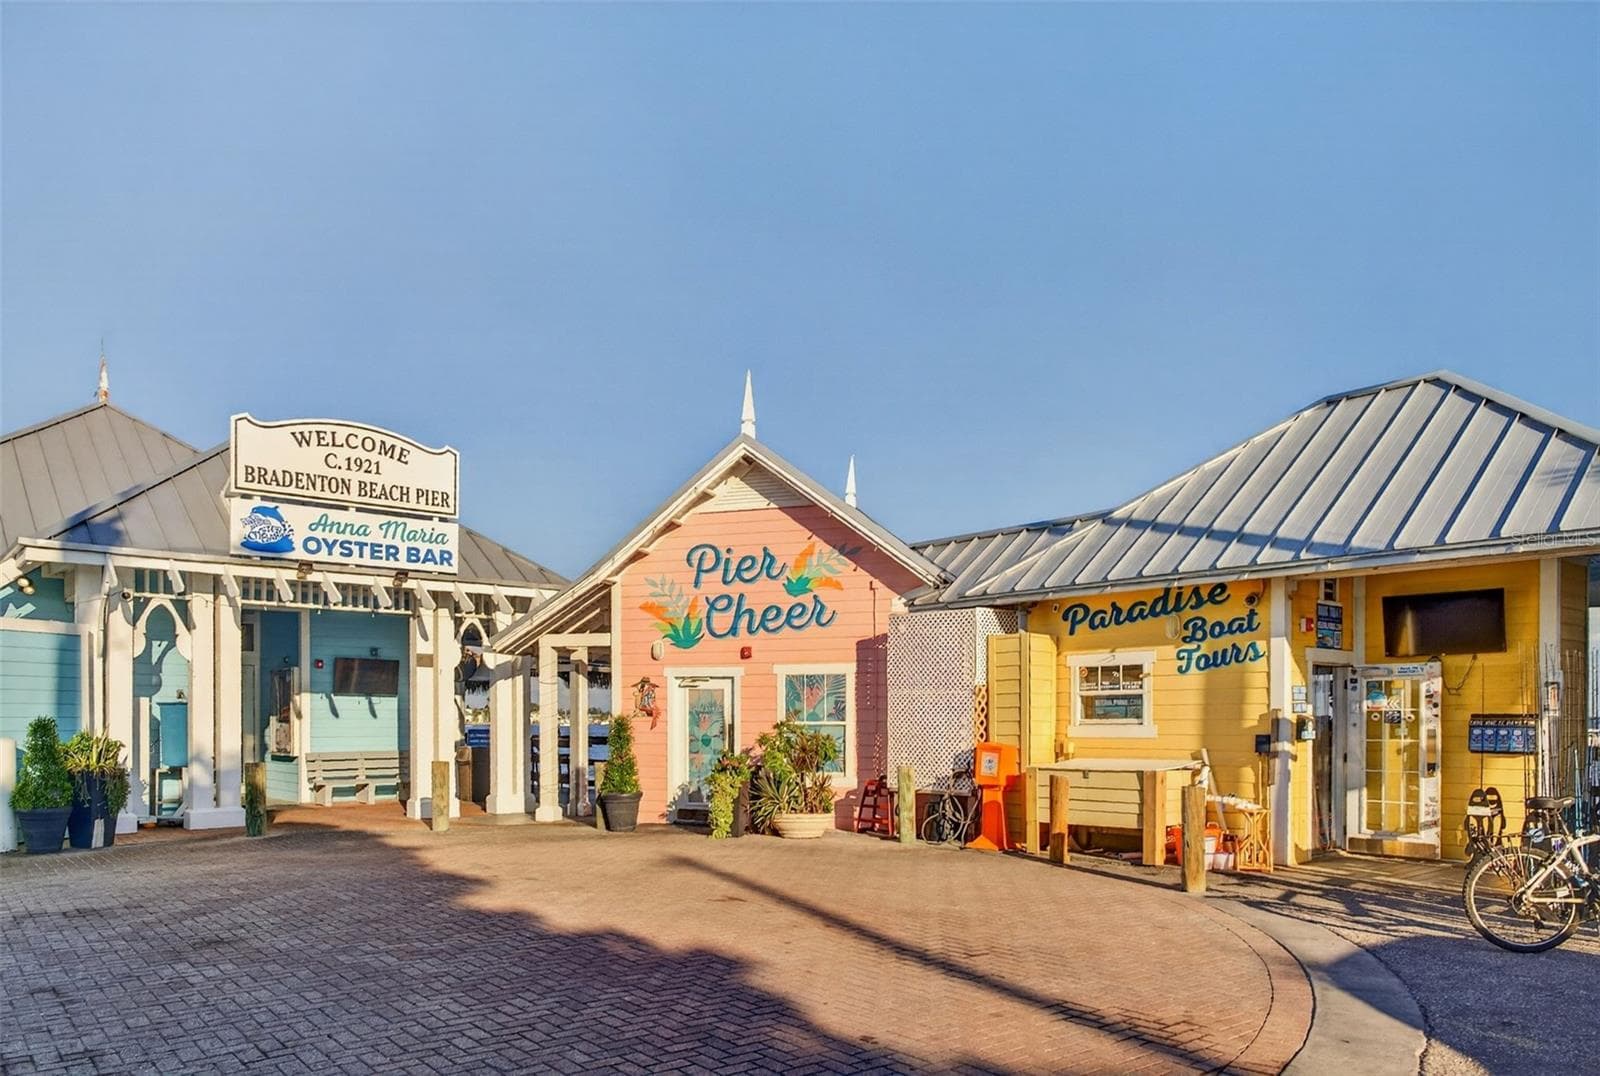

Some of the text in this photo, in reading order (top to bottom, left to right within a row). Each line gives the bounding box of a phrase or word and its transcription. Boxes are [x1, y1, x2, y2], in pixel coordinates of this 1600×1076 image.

[290, 430, 411, 465] WELCOME
[324, 452, 383, 475] C.1921
[244, 464, 451, 508] BRADENTON BEACH PIER
[308, 513, 449, 546] Anna Maria
[302, 536, 400, 562] OYSTER
[405, 546, 454, 567] BAR
[686, 543, 788, 590] Pier
[704, 592, 838, 639] Cheer
[1062, 581, 1231, 636] Paradise
[1181, 608, 1261, 644] Boat
[1176, 640, 1266, 675] Tours
